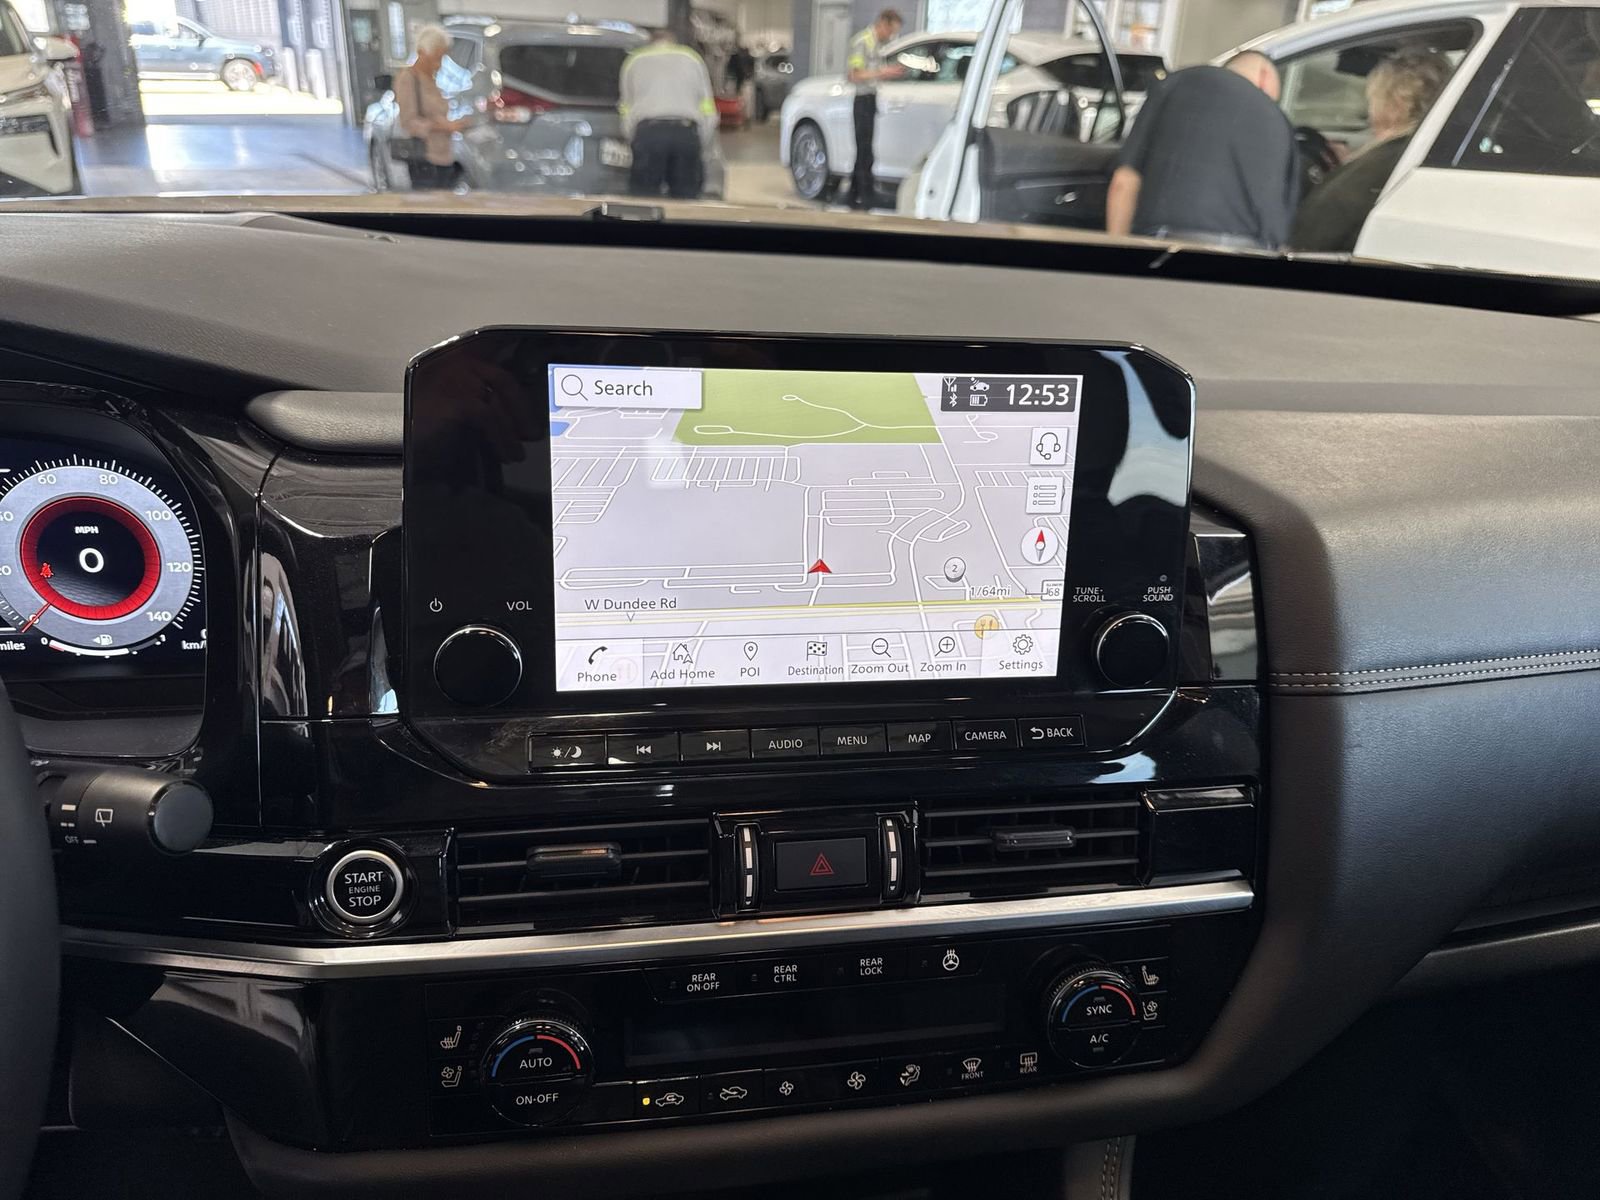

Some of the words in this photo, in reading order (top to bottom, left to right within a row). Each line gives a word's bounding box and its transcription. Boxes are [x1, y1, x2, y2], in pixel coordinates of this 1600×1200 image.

[594, 380, 653, 396] Search
[1006, 384, 1070, 406] 12:53
[38, 475, 57, 485] 60
[100, 475, 118, 485] 80
[146, 511, 172, 521] 100
[75, 526, 99, 534] MPH
[79, 548, 104, 572] 0
[166, 562, 192, 573] 120
[952, 564, 958, 573] 2
[970, 586, 1011, 598] 1/64mi
[1147, 586, 1171, 594] PUSH
[1073, 594, 1106, 602] SCROLL
[1142, 593, 1174, 602] SOUND
[506, 600, 533, 611] VOL
[584, 599, 600, 610] W
[603, 598, 656, 610] Dundee
[660, 597, 677, 609] Rd
[146, 611, 172, 622] 140
[40, 637, 48, 646] 0
[788, 665, 844, 676] Destination
[851, 664, 883, 674] Zoom
[887, 663, 909, 673] Out
[920, 662, 952, 672] Zoom
[955, 662, 966, 672] In
[999, 660, 1043, 671] Settings
[577, 672, 617, 682] Phone
[650, 670, 677, 680] Add
[680, 669, 716, 679] Home
[740, 667, 760, 677] POI
[908, 733, 932, 743] MAP
[964, 730, 1007, 741] CAMERA
[1046, 727, 1074, 738] BACK
[768, 739, 803, 750] AUDIO
[837, 735, 868, 746] MENU
[344, 871, 383, 884] START
[348, 885, 381, 894] ENGINE
[348, 895, 382, 907] STOP
[860, 957, 883, 967] REAR
[773, 964, 798, 974] REAR
[860, 965, 883, 976] LOCK
[691, 972, 716, 982] REAR
[773, 973, 797, 983] CTRL
[1086, 1004, 1113, 1016] SYNC
[1089, 1033, 1109, 1044] A/C
[519, 1057, 553, 1069] AUTO
[961, 1071, 984, 1080] FRONT
